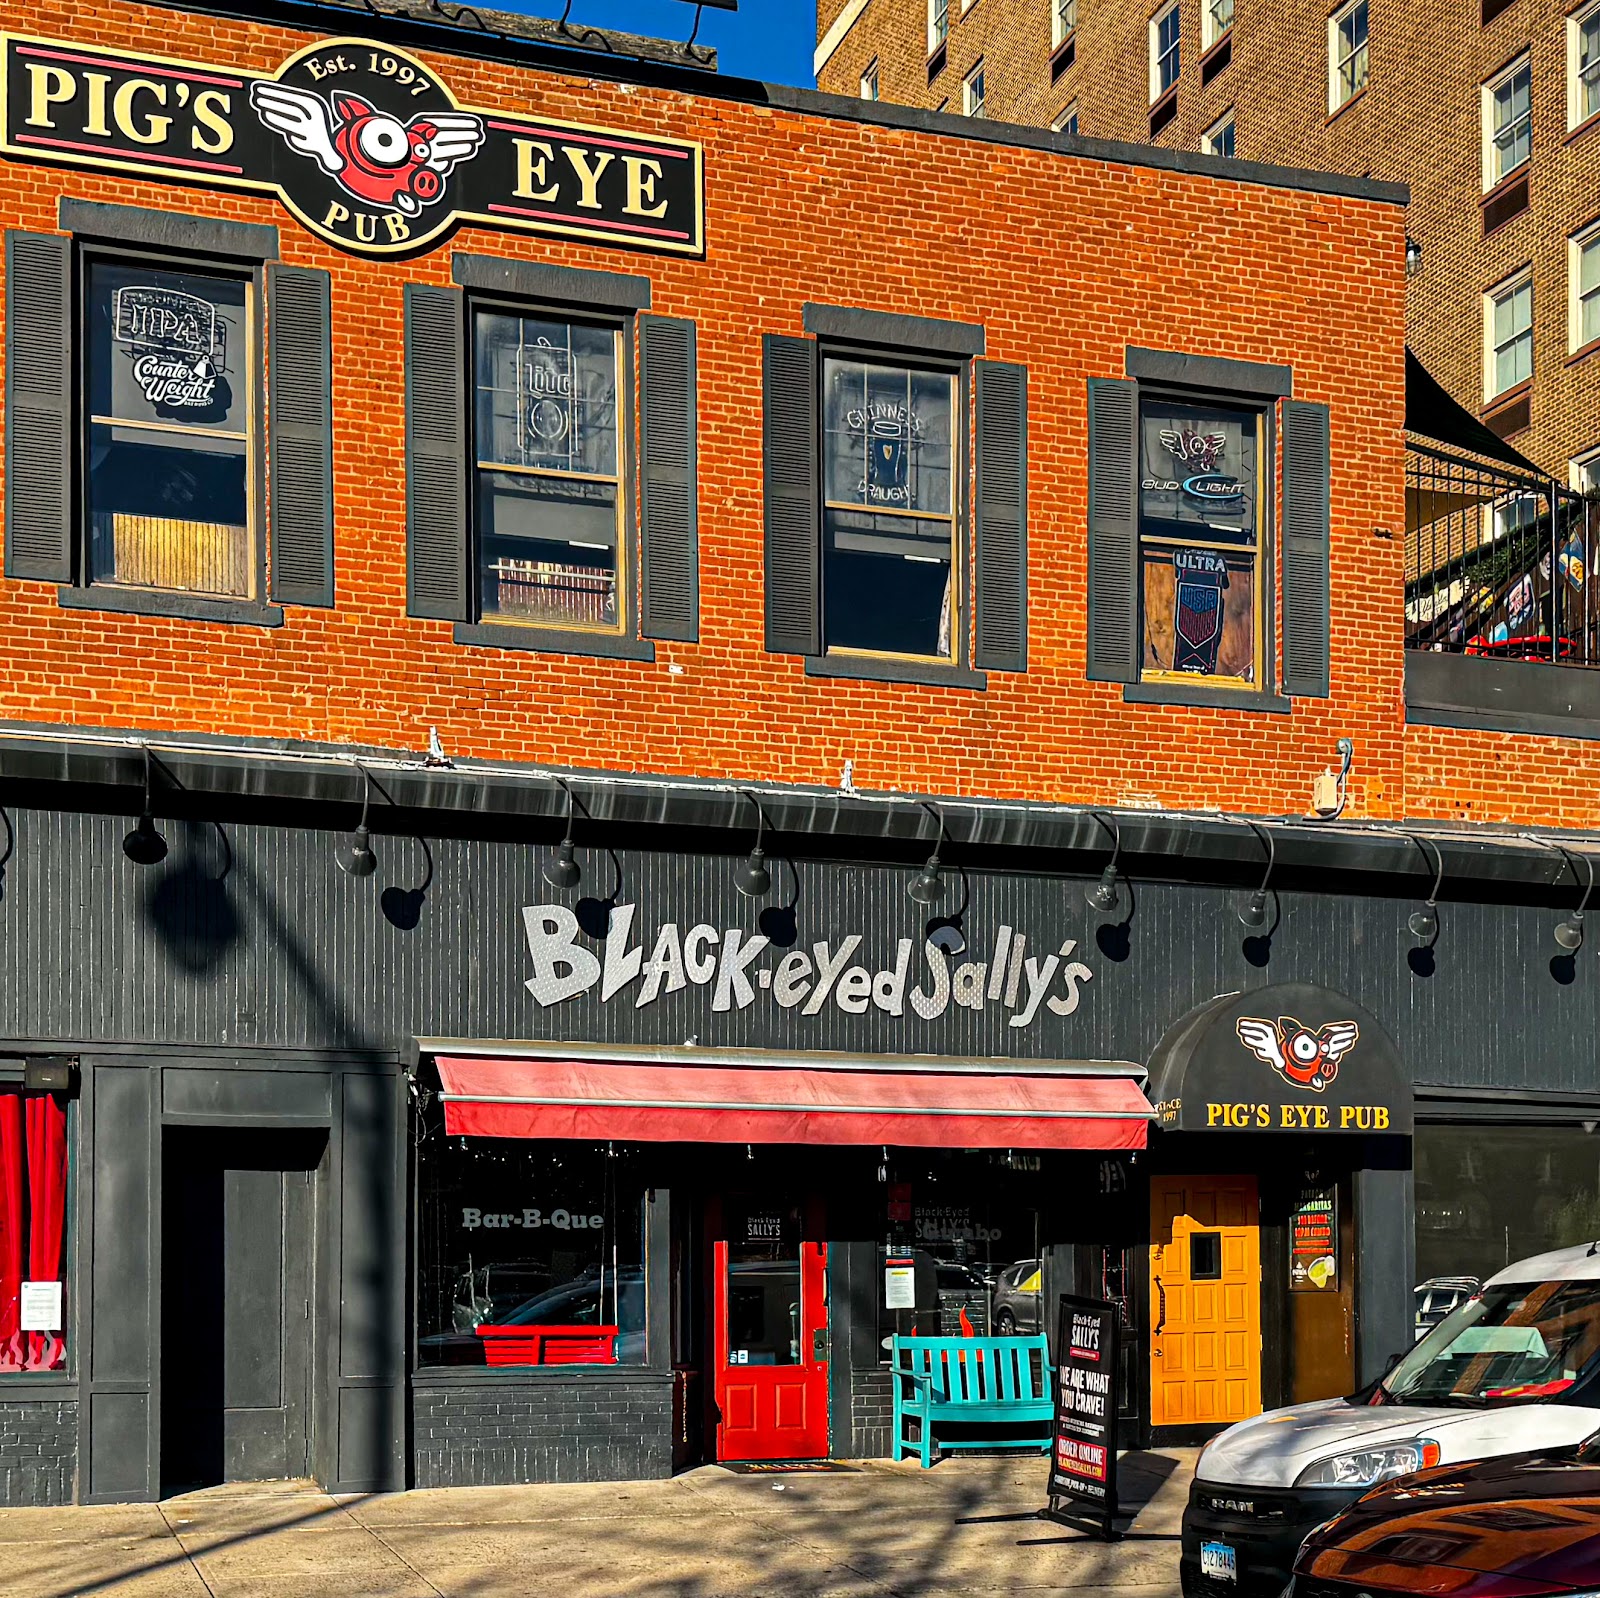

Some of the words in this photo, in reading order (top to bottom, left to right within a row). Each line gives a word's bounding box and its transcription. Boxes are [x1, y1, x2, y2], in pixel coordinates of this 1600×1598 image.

[304, 54, 357, 82] Est.
[368, 52, 431, 98] 1997
[25, 63, 234, 154] PIG'S
[511, 137, 670, 220] EYE
[322, 205, 411, 243] PUB
[134, 355, 196, 382] Counter
[141, 376, 216, 407] Weight
[858, 480, 912, 501] DRAUGH
[1141, 479, 1180, 490] BUD
[1195, 481, 1247, 494] LIGHT
[1175, 553, 1227, 573] ULTRA
[909, 924, 1094, 1028] Sally's
[1206, 1102, 1272, 1129] PIG'S
[1280, 1104, 1331, 1129] EYE
[1339, 1105, 1391, 1130] PUB
[461, 1208, 605, 1231] Bar-B-Que
[747, 1224, 781, 1236] SALLY'S
[1071, 1325, 1099, 1349] SALLY'S
[1060, 1365, 1070, 1386] WE
[1070, 1367, 1085, 1390] ARE
[1085, 1370, 1110, 1394] WHAT
[1061, 1388, 1075, 1409] YOU
[1075, 1392, 1104, 1416] CRAVE!
[1058, 1438, 1079, 1459] ORDER
[1078, 1444, 1103, 1465] ONLINE
[1211, 1498, 1254, 1513] RAM
